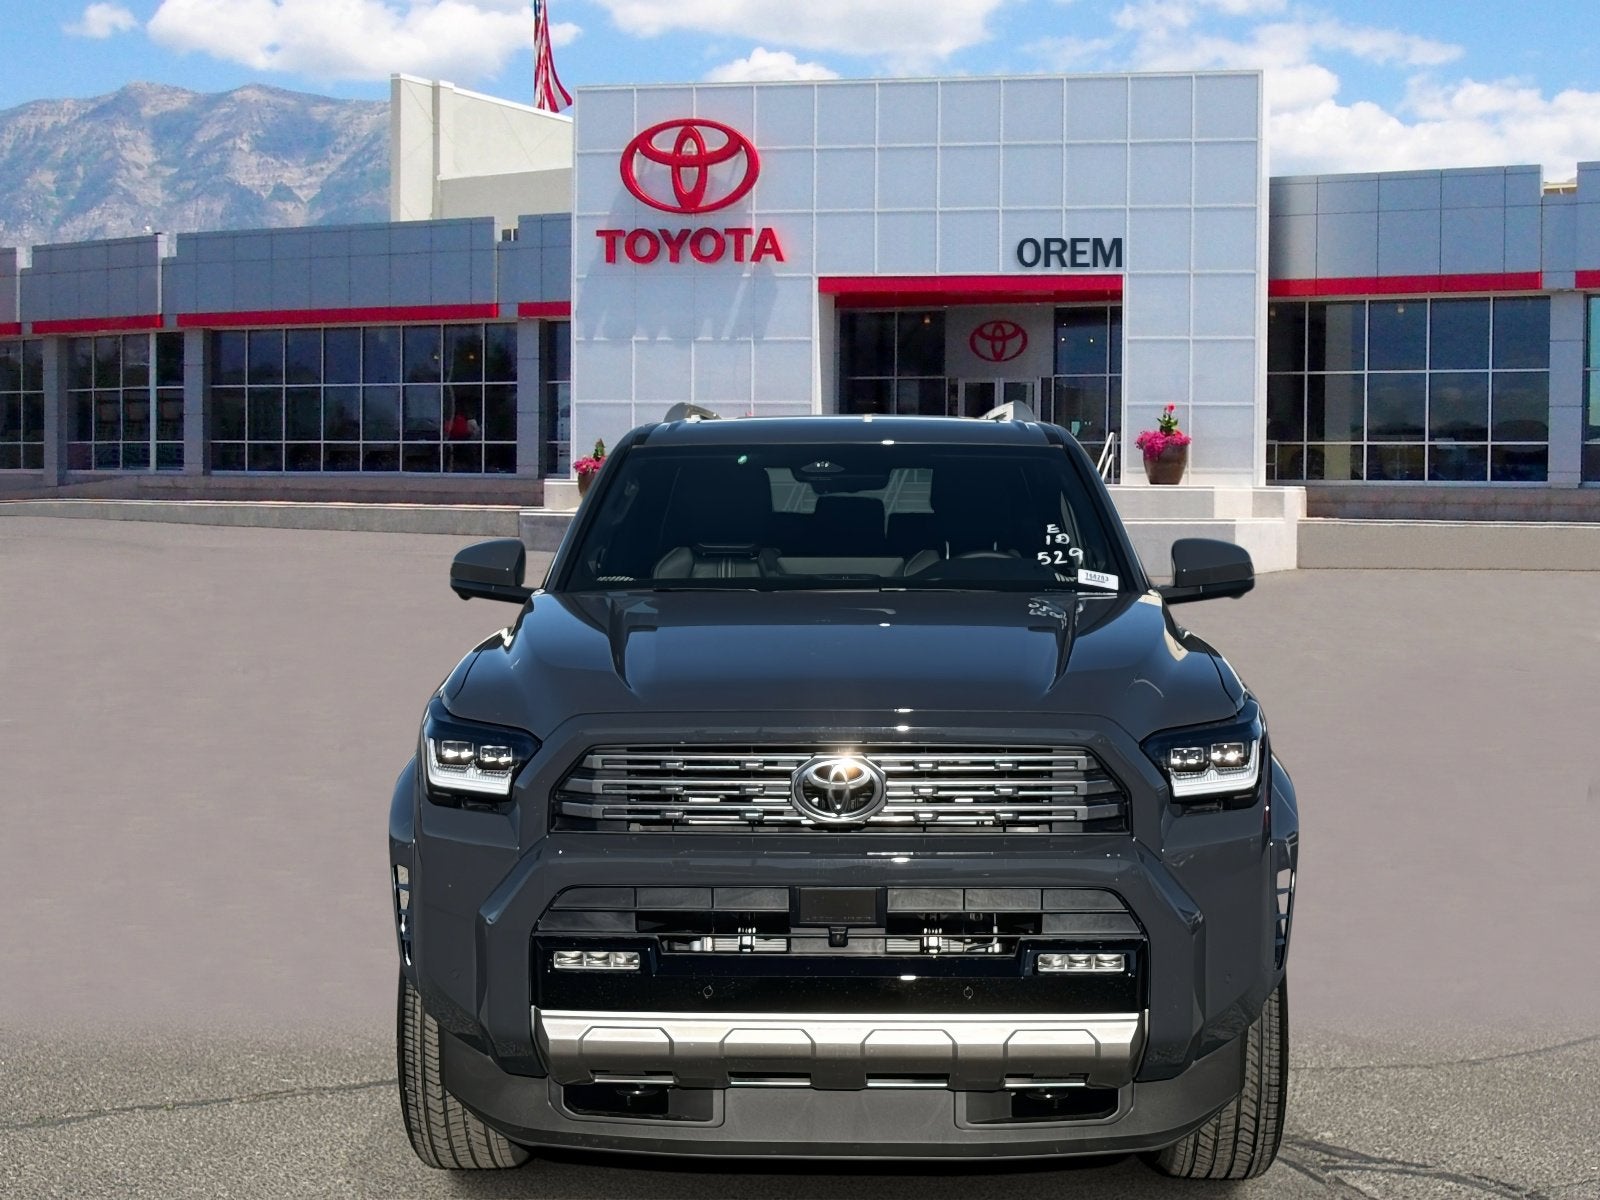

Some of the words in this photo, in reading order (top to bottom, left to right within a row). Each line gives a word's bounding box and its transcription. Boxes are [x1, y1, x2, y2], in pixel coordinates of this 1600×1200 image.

[596, 227, 785, 264] TOYOTA
[1016, 237, 1123, 268] OREM
[1037, 547, 1084, 565] 529
